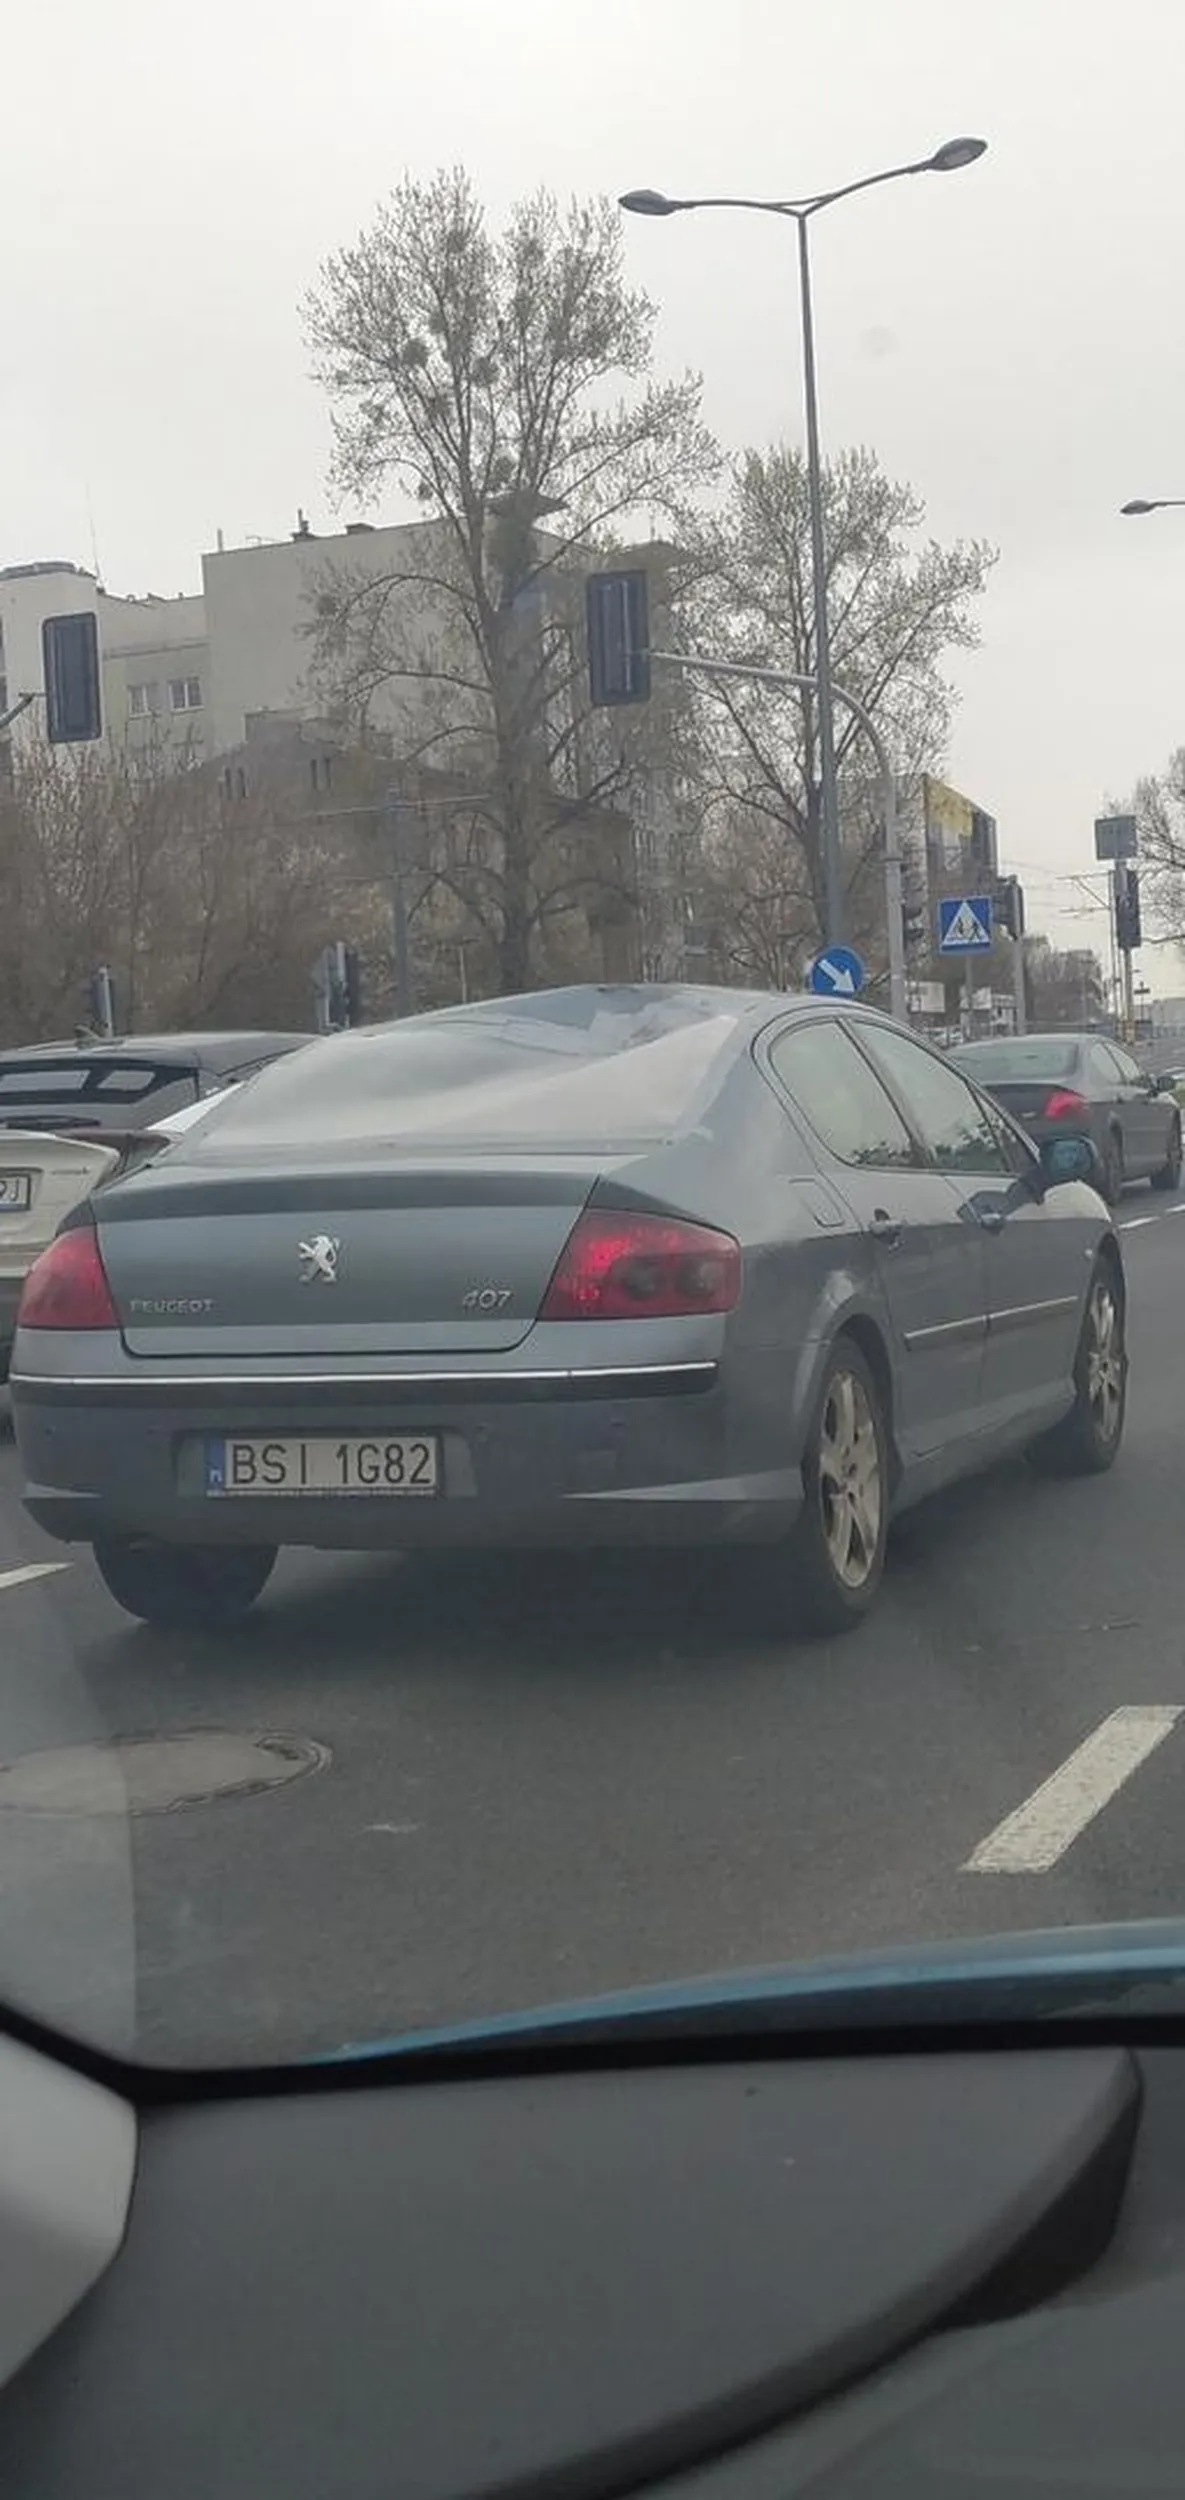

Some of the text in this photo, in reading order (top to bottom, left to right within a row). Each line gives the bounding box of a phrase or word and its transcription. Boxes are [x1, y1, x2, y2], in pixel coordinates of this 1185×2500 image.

[130, 1298, 214, 1314] PEUGEOT
[462, 1288, 512, 1310] 407
[231, 1443, 431, 1486] BSI 1G82
